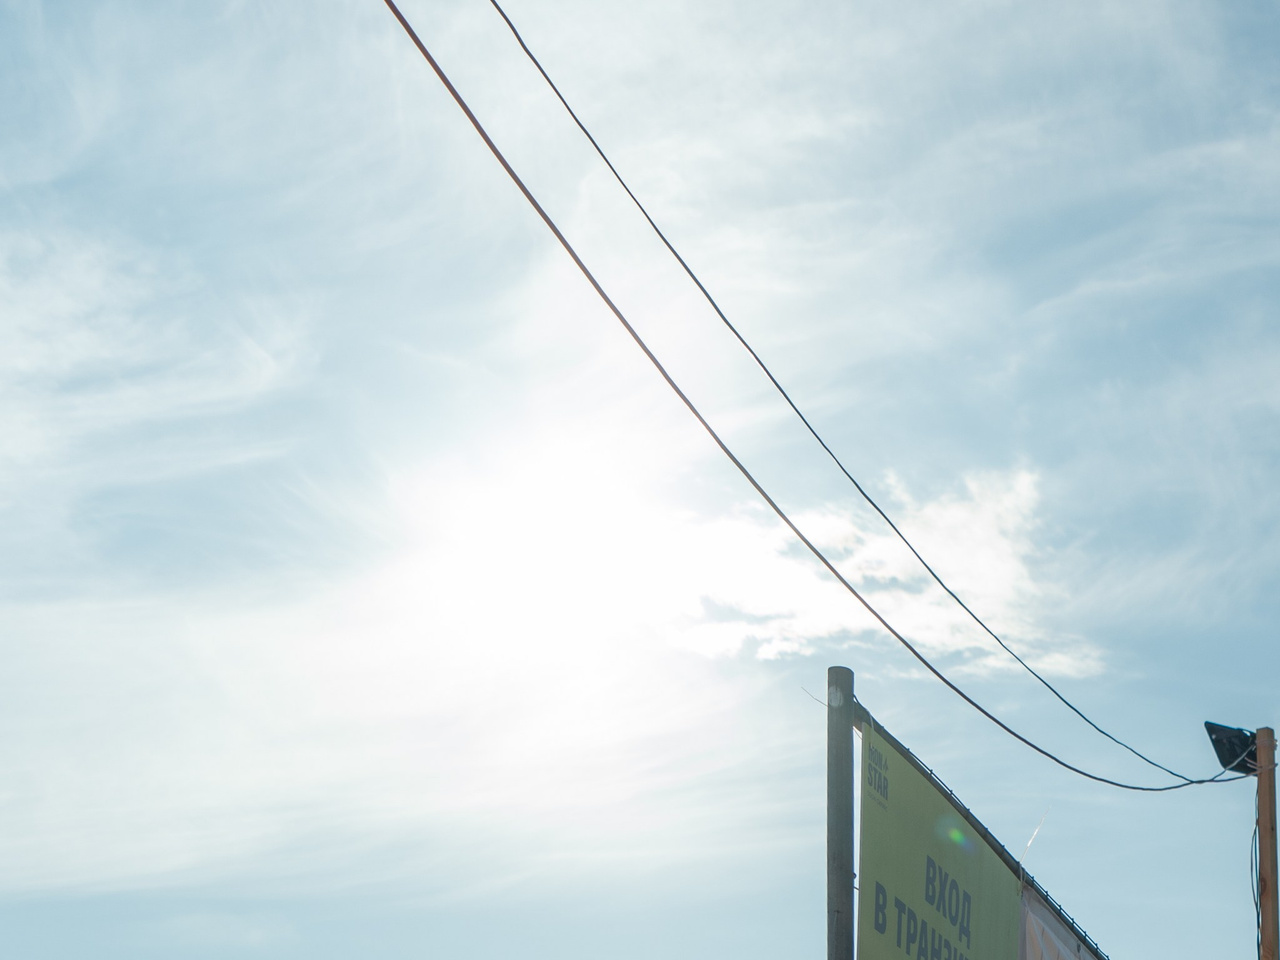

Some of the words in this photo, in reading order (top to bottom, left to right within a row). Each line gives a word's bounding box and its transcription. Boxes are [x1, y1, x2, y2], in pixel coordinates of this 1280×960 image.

[867, 763, 889, 801] STAR
[873, 880, 888, 935] В
[925, 854, 972, 950] ВХОД
